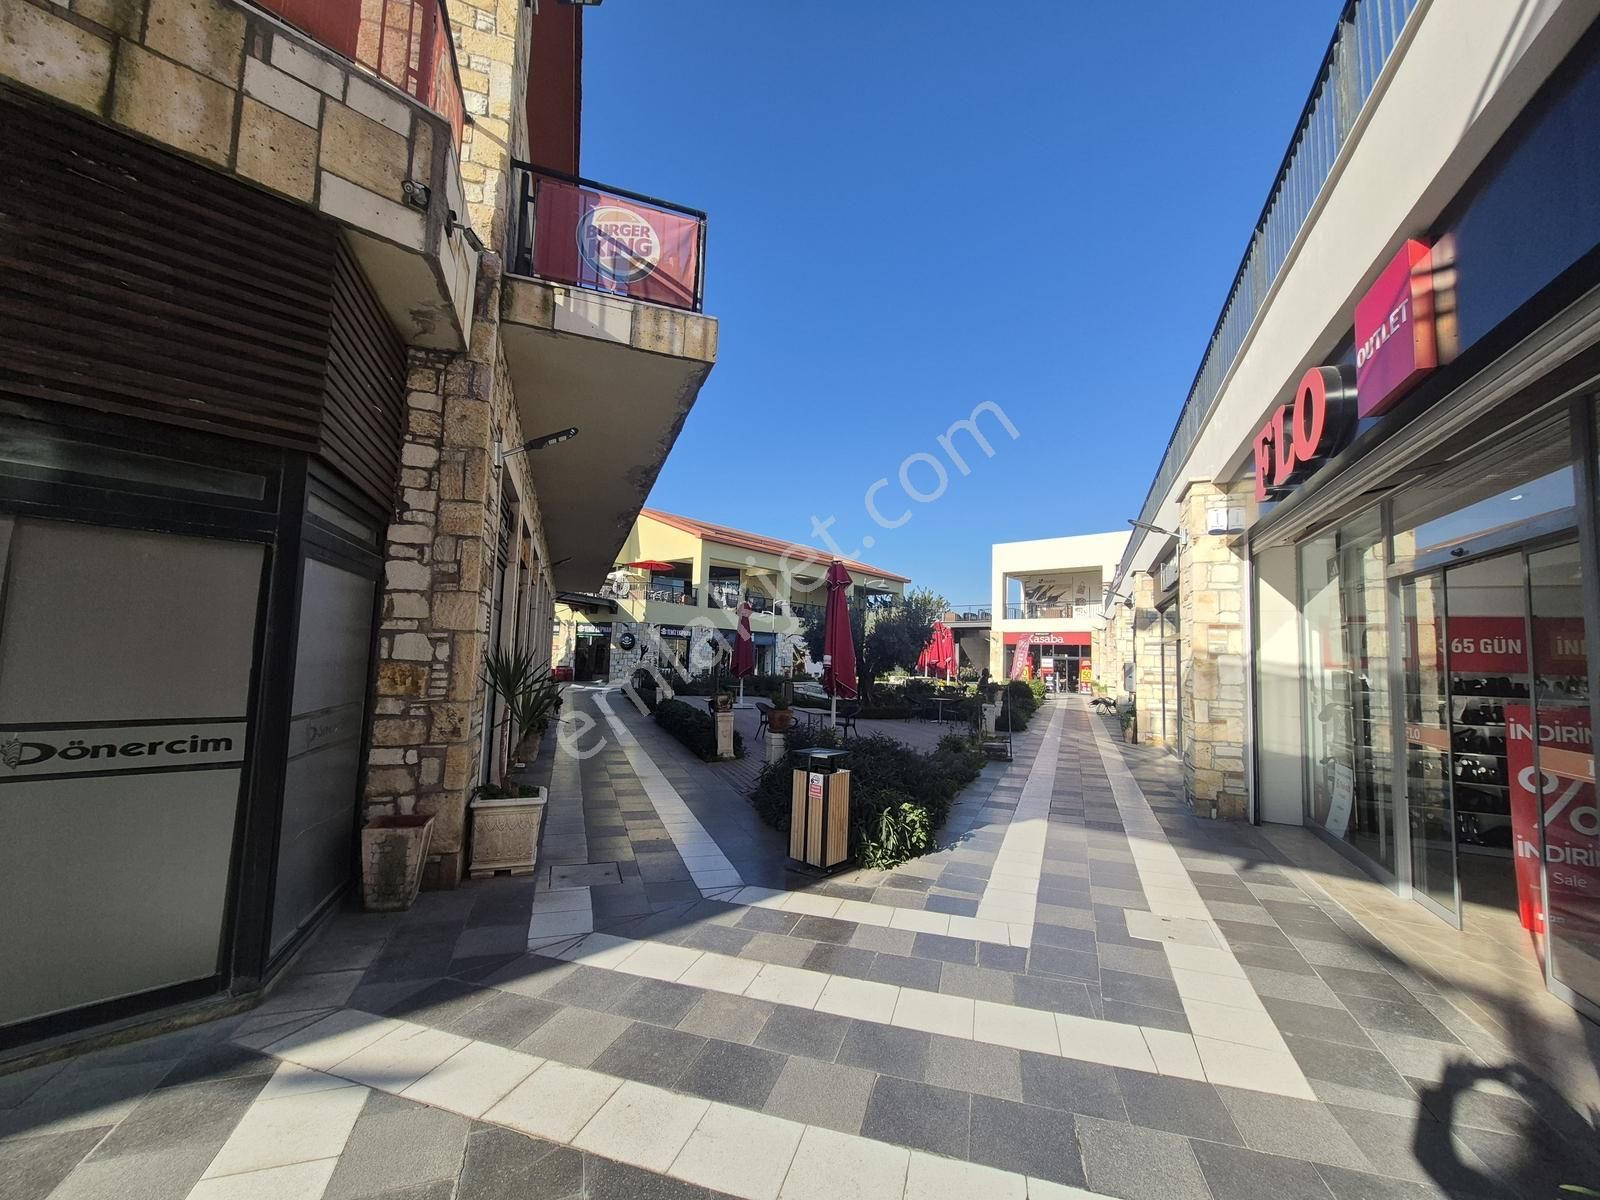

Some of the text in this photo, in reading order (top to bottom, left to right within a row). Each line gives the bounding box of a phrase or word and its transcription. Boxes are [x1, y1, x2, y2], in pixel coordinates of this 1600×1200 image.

[587, 223, 649, 238] BURGER
[588, 238, 653, 259] KING
[1357, 298, 1409, 369] OUTLET
[1253, 367, 1326, 502] FLO
[1480, 635, 1522, 655] GÜN
[14, 734, 233, 766] Dönercim
[1552, 871, 1588, 889] Sale
